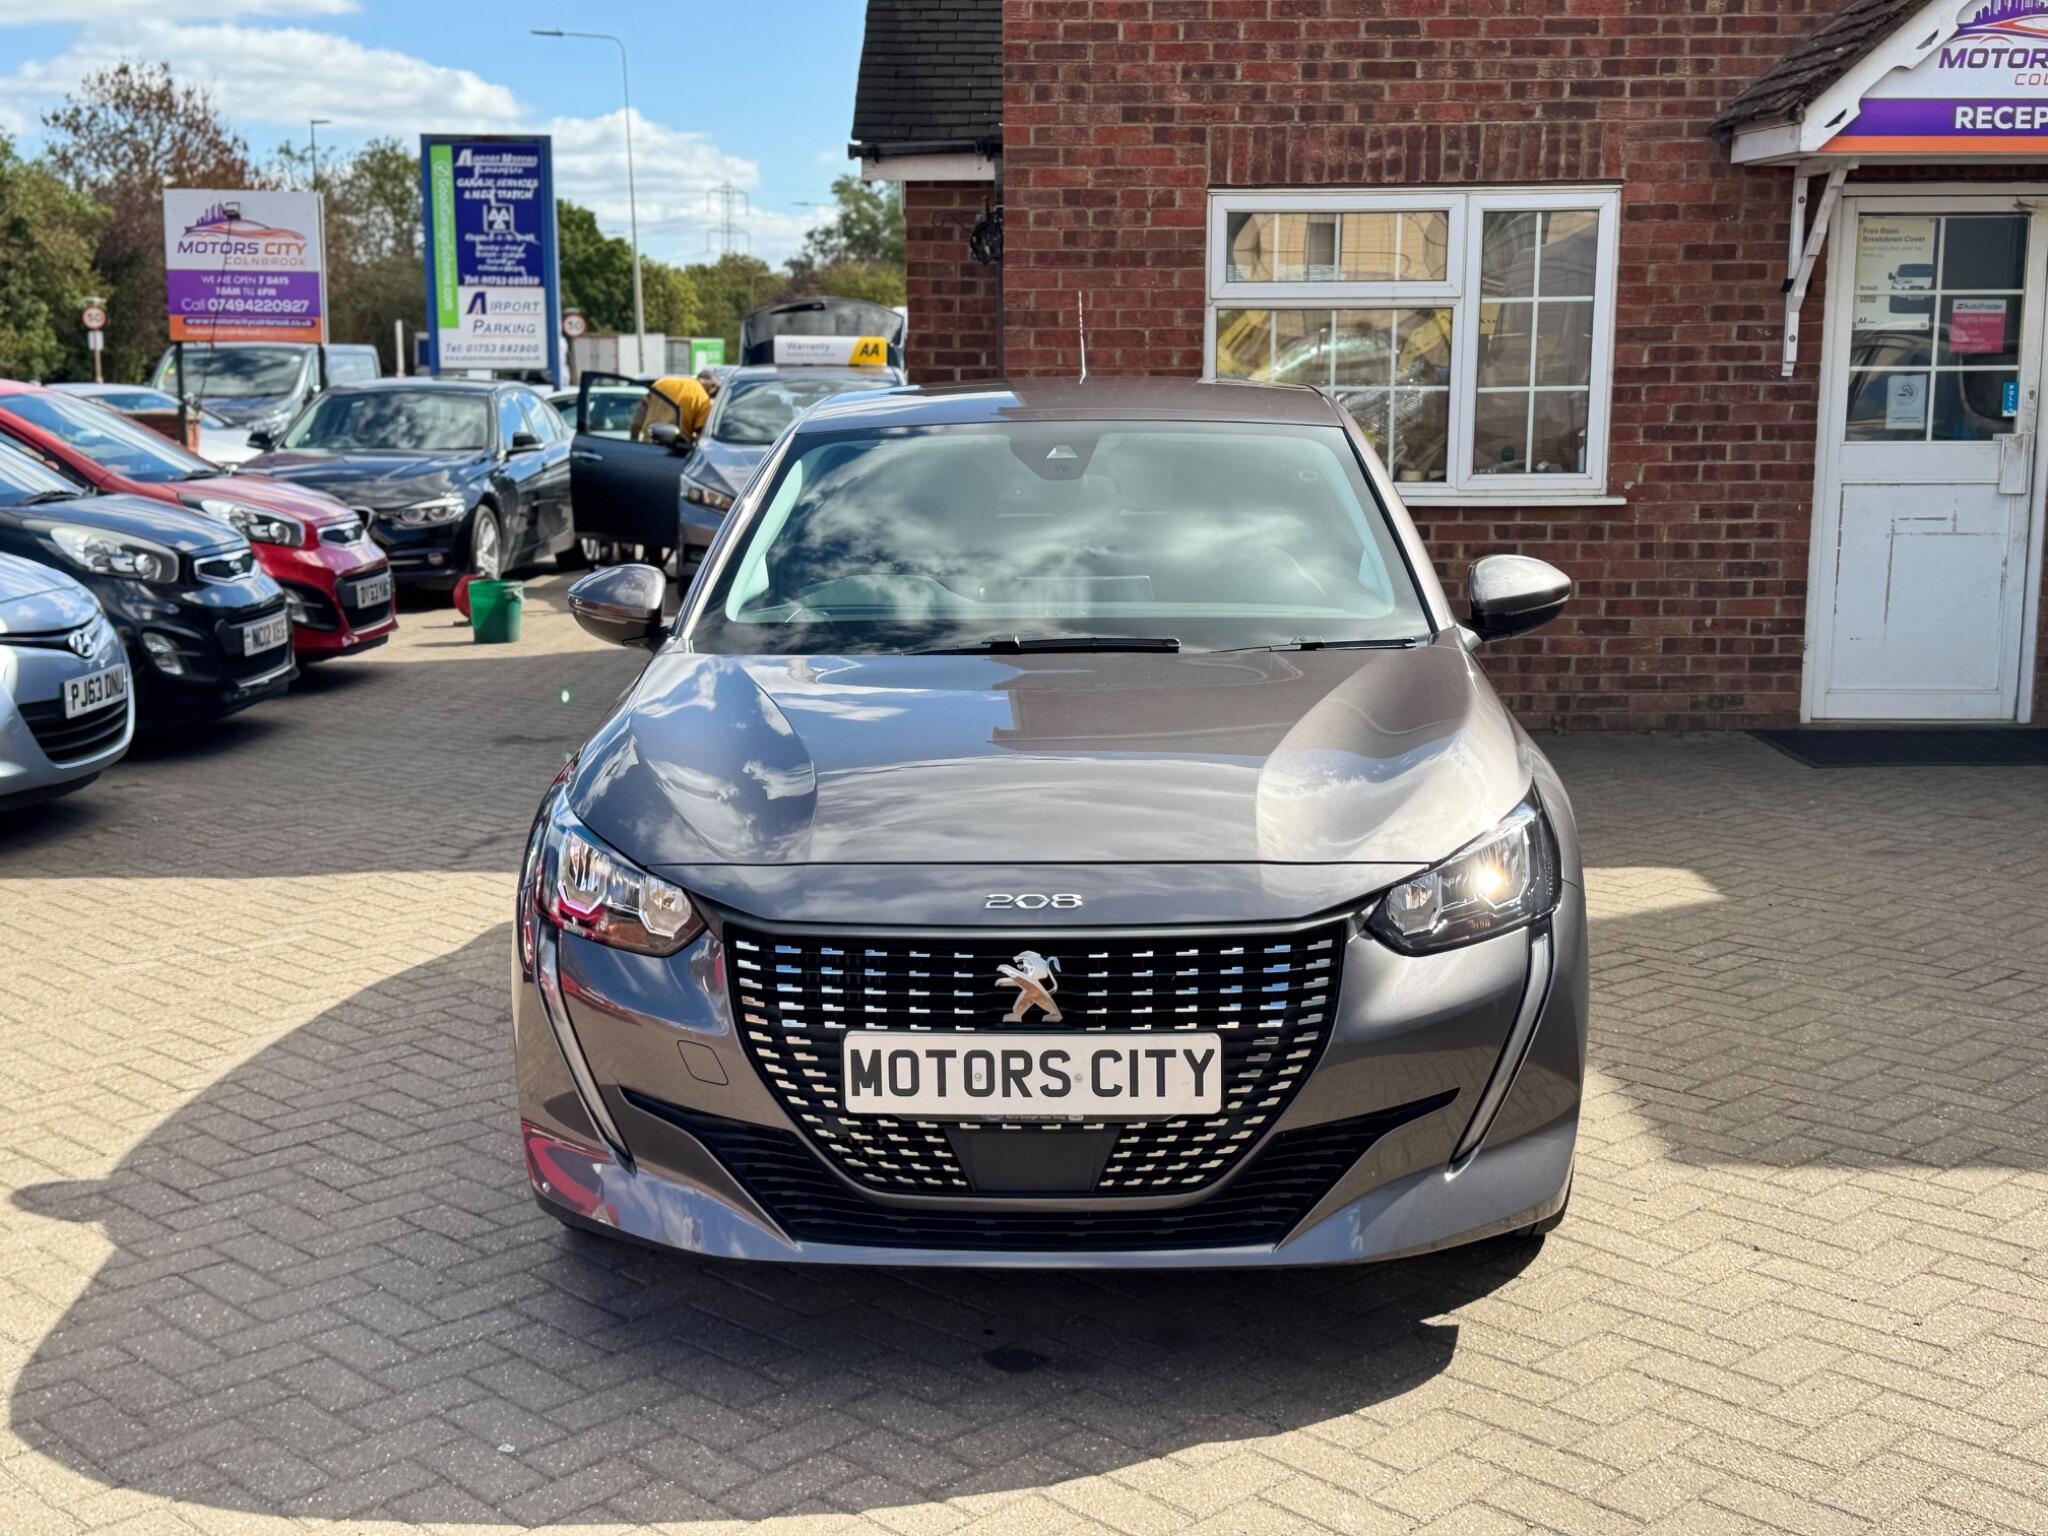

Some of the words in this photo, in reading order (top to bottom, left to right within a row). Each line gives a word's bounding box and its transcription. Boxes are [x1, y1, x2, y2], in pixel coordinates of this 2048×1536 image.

[1955, 106, 2048, 129] RECEP
[177, 240, 259, 255] MOTORS
[264, 242, 308, 256] CITY
[224, 256, 307, 267] COLNBROOK
[201, 275, 214, 284] WE
[233, 276, 257, 285] OPEN
[258, 276, 265, 285] 7
[266, 276, 290, 286] DAYS
[181, 298, 206, 311] Call
[207, 299, 310, 313] 07494220927
[466, 291, 541, 315] AIRPORT
[87, 312, 102, 323] 50
[472, 319, 537, 334] PARKING
[567, 320, 582, 331] 50
[445, 343, 463, 353] Tel:
[465, 343, 497, 353] 01753
[499, 343, 540, 353] 682800
[785, 341, 832, 352] Warranty
[859, 343, 880, 357] AA
[71, 676, 103, 711] PJ63
[984, 893, 1083, 909] 208
[850, 1049, 1071, 1098] MOTORS
[1091, 1049, 1215, 1098] CITY
